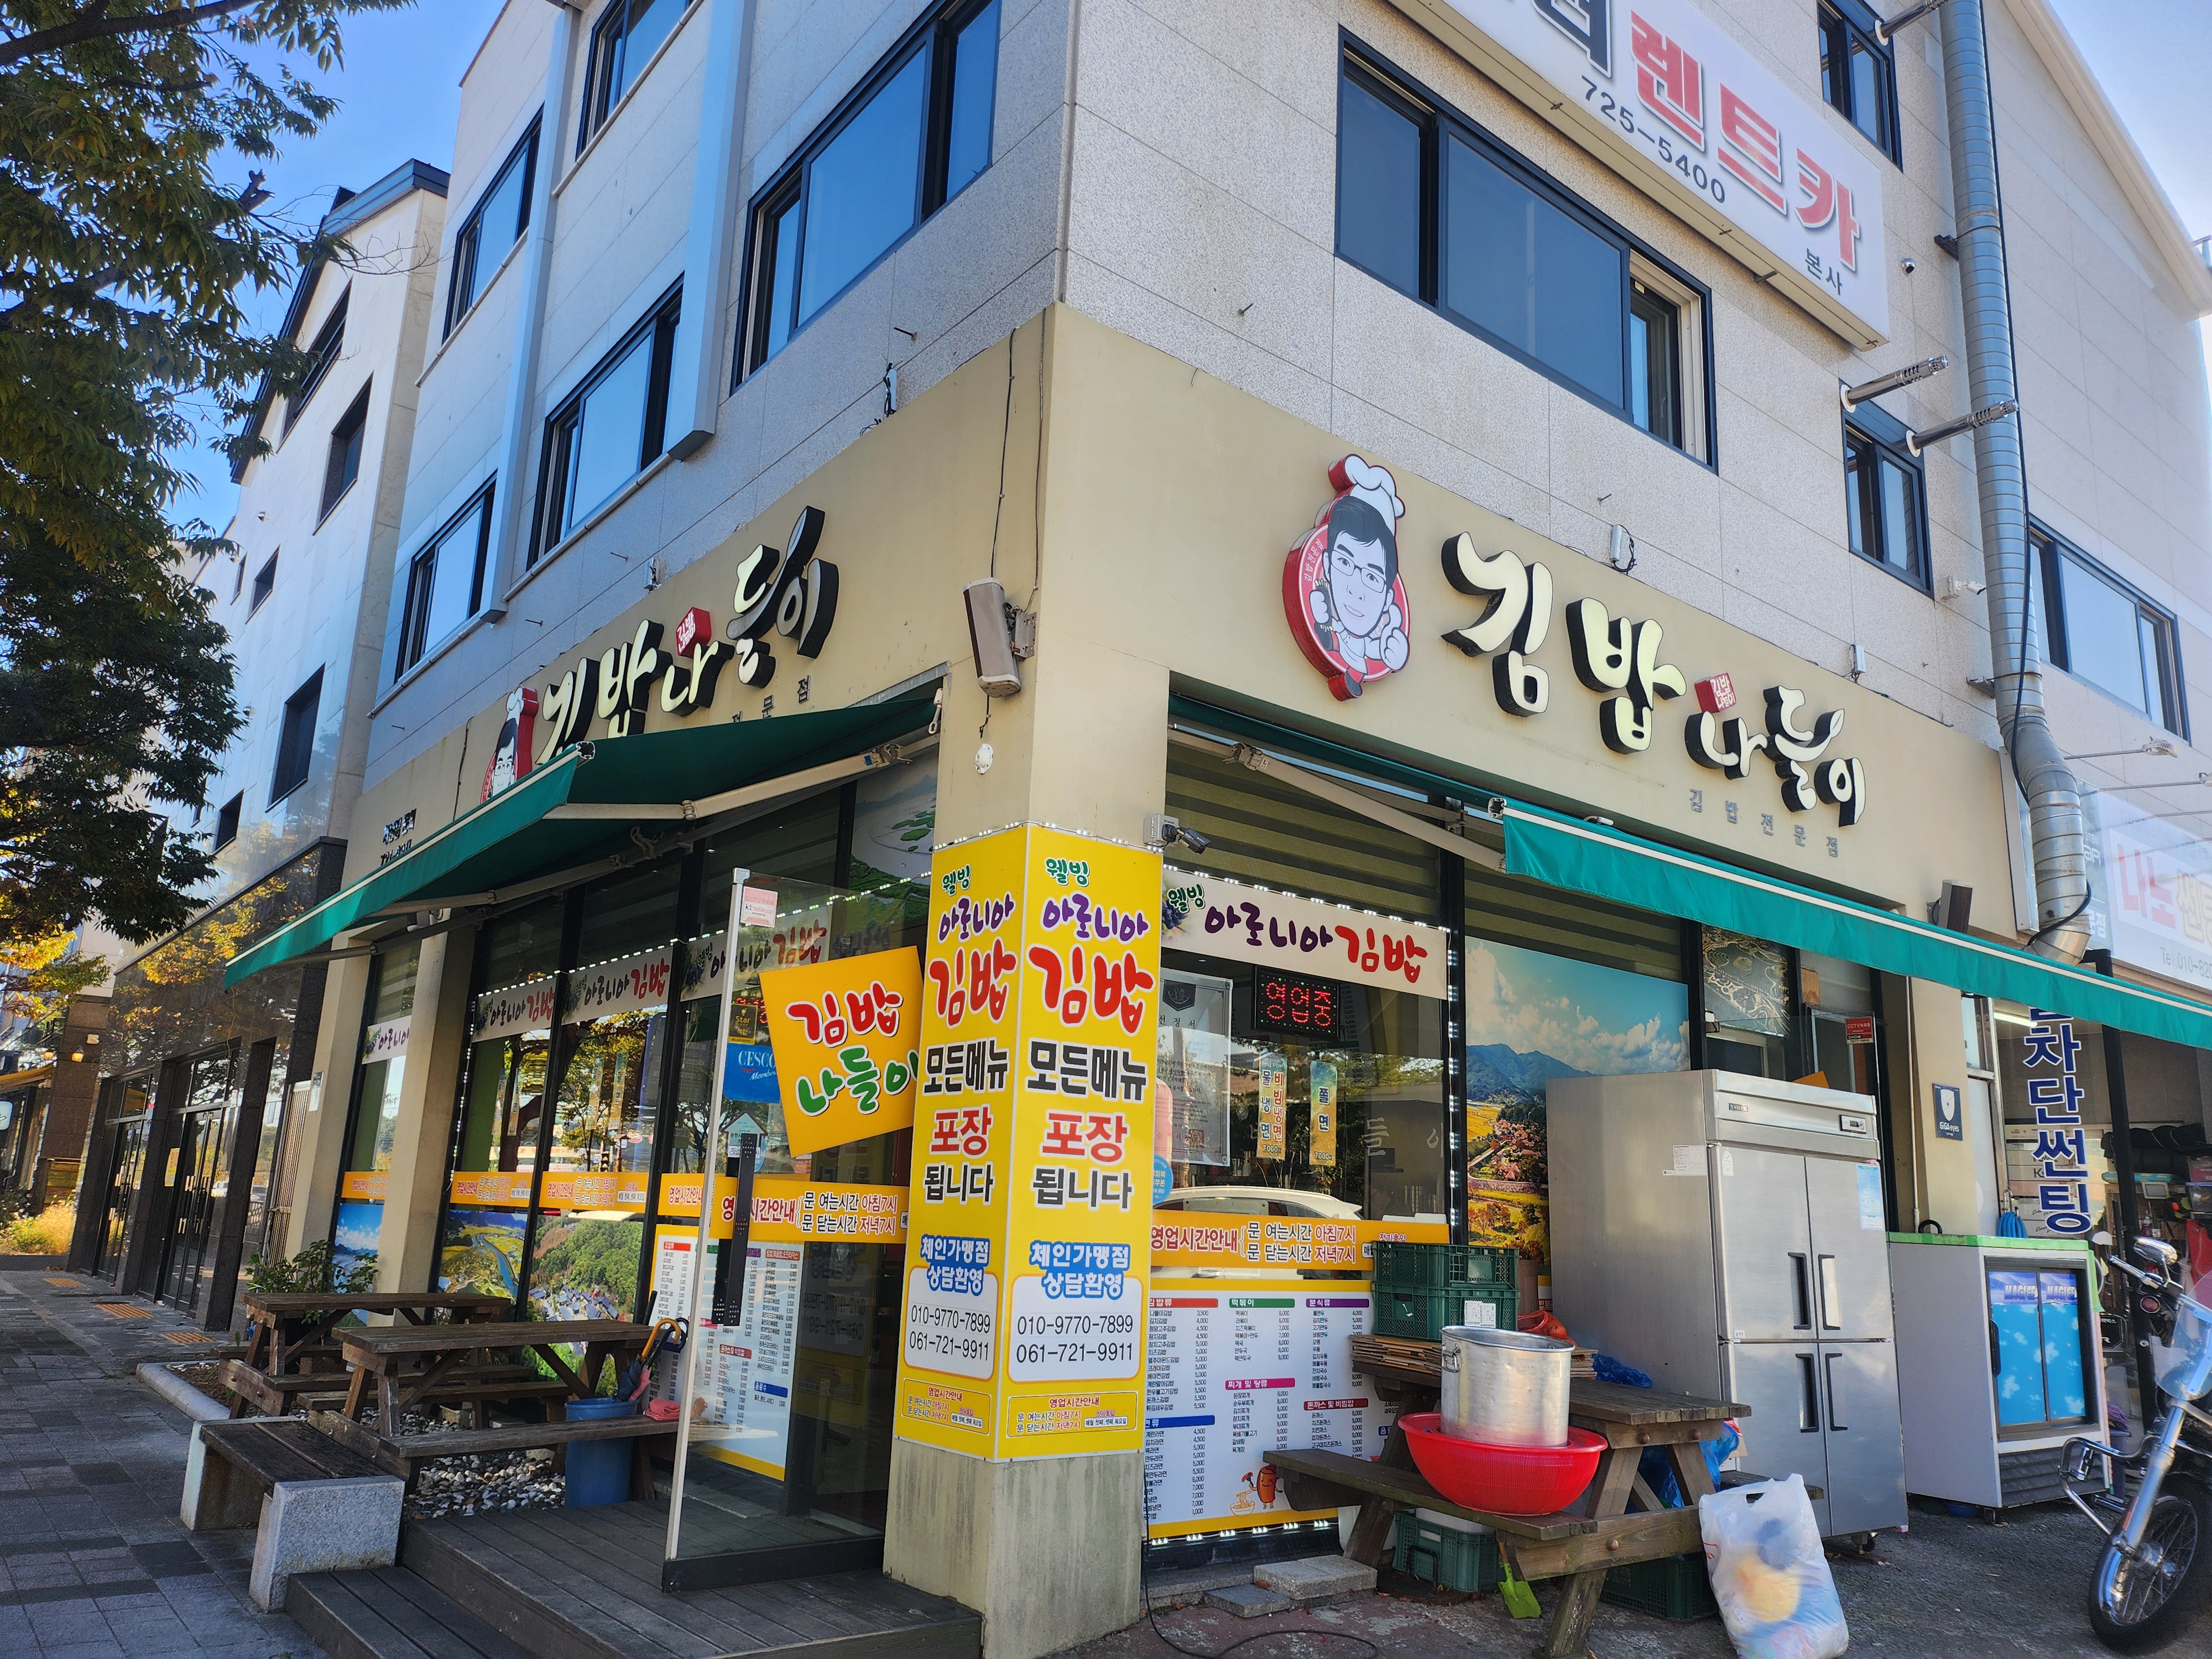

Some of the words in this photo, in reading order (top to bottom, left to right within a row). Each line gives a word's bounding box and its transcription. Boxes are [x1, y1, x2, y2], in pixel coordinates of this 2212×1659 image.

[1581, 75, 1725, 204] 725-5400
[1631, 11, 1859, 271] 렌트카
[1805, 248, 1842, 295] 본사
[1303, 538, 1324, 582] 김밥전문점
[1689, 789, 1838, 858] 김밥전문점
[942, 864, 972, 896] 웰빙
[1046, 859, 1089, 886] 웰빙
[2117, 843, 2176, 930] 나노
[753, 906, 774, 915] telecop
[940, 891, 1015, 942] 아로니아
[1042, 893, 1150, 942] 아로니아
[711, 941, 771, 978] 아니아
[773, 920, 827, 964] 김밥
[1167, 884, 1206, 914] 웰빙
[1204, 902, 1333, 952] 아로니아
[1335, 925, 1427, 983] 김밥
[584, 973, 630, 1005] 아로니아
[631, 957, 670, 999] 김밥
[928, 937, 1018, 1027] 김밥
[1027, 946, 1155, 1034] 김밥
[527, 987, 555, 1022] 김밥
[735, 1015, 751, 1024] Star
[786, 980, 903, 1047] 김밥
[1266, 982, 1331, 1026] 영업중
[796, 1046, 919, 1116] 나들이
[924, 1039, 1008, 1094] 모든메뉴
[1027, 1039, 1147, 1102] 모든메뉴
[1260, 1069, 1272, 1140] 물냉면
[1272, 1072, 1284, 1142] 비빔냉면
[1318, 1087, 1329, 1132] 쫄면
[2023, 1006, 2092, 1234] 차단썬팅
[931, 1104, 993, 1156] 포장
[1042, 1112, 1129, 1165] 포장
[804, 1191, 815, 1209] 문
[819, 1192, 859, 1212] 여는시간
[861, 1193, 898, 1214] 아침7시
[924, 1163, 994, 1203] 됩니다
[1032, 1167, 1133, 1210] 됩니다
[722, 1196, 796, 1223] 영시간안내
[801, 1214, 813, 1233] 문
[817, 1214, 857, 1235] 닫는시간
[859, 1215, 896, 1236] 저녁7시
[921, 1235, 990, 1266] 체인가맹점
[1151, 1224, 1238, 1253] 영업시간안내
[1247, 1221, 1260, 1239] 문
[1265, 1222, 1312, 1243] 여는시간
[1314, 1224, 1357, 1244] 아침7시
[1031, 1243, 1129, 1269] 체인가맹점
[1247, 1243, 1260, 1261] 문
[1265, 1243, 1312, 1264] 닫는시간
[1314, 1244, 1357, 1264] 저녁7시
[928, 1266, 984, 1295] 상담환영
[1044, 1272, 1124, 1298] 상담환영
[911, 1305, 990, 1334] 010-9770-7899
[1017, 1316, 1134, 1335] 010-9770-7899
[910, 1331, 989, 1361] 061-721-9911
[1016, 1343, 1133, 1363] 061-721-9911
[928, 1387, 962, 1402] 영업시간안내
[1050, 1397, 1099, 1408] 영업시간안내
[1254, 1380, 1267, 1388] 탕류
[932, 1401, 949, 1411] 아침7시
[1027, 1412, 1054, 1421] 여는시간
[1057, 1410, 1081, 1419] 아침7시
[1016, 1425, 1024, 1433] 문
[1027, 1422, 1054, 1432] 닫는시간
[1056, 1421, 1081, 1430] 저녁7시
